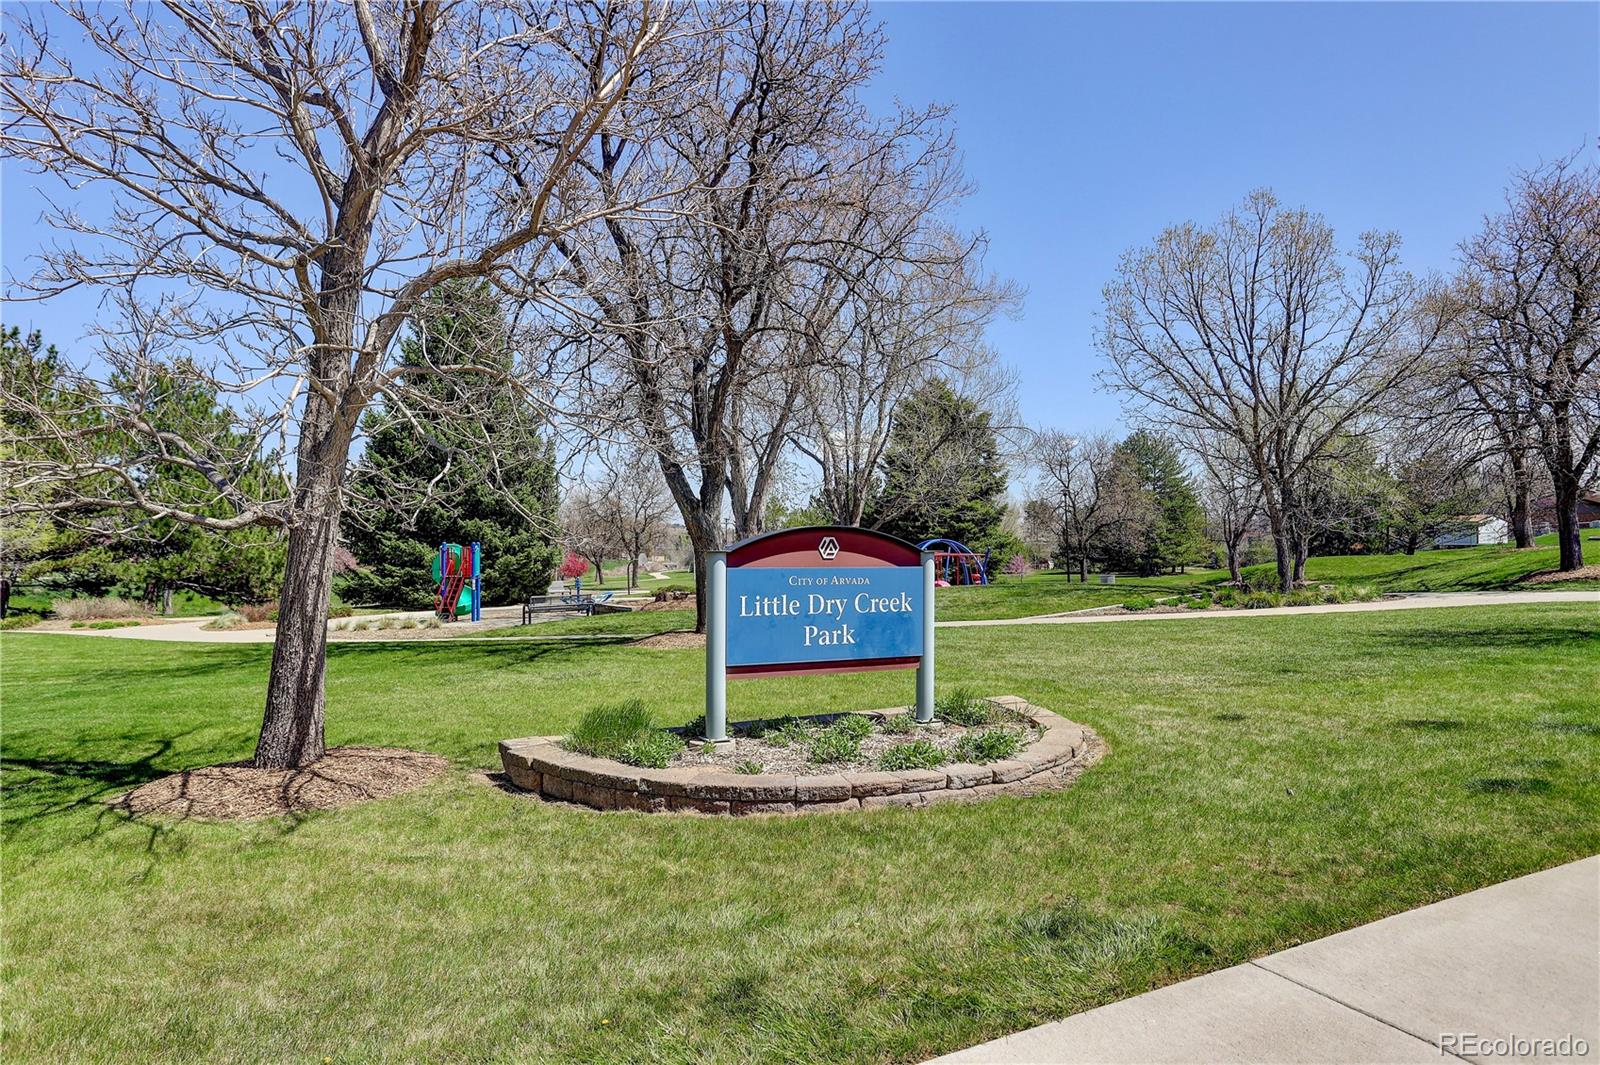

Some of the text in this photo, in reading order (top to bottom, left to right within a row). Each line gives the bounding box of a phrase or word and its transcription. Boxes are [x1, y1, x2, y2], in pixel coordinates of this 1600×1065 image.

[739, 591, 913, 620] Little Dry Creek
[803, 623, 856, 647] Park
